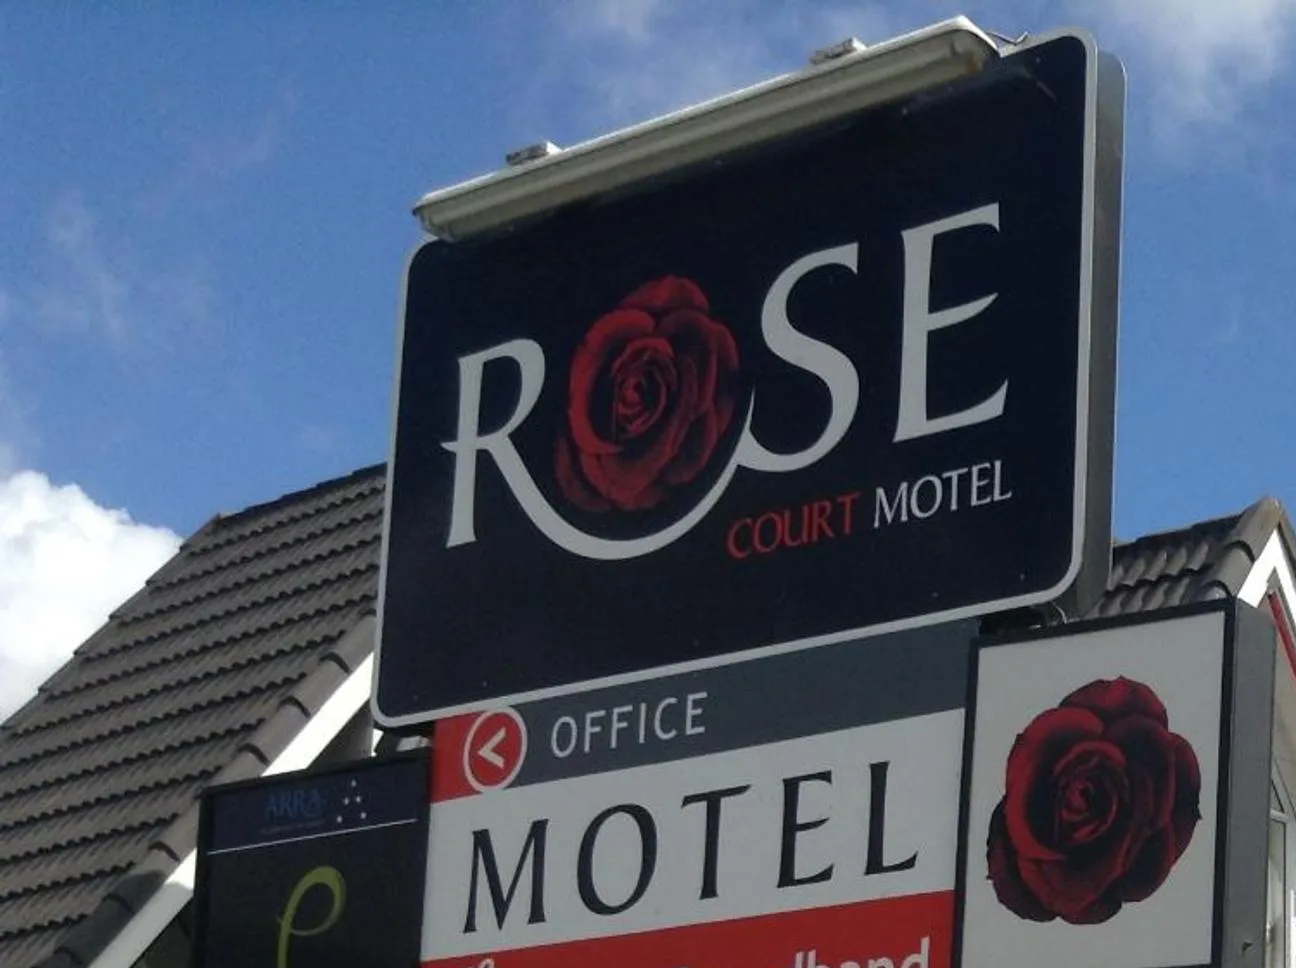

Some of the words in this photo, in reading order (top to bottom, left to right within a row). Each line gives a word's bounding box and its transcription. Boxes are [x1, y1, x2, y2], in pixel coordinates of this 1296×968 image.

[441, 203, 1008, 560] ROSE
[726, 491, 861, 559] COURT
[873, 460, 1012, 529] MOTEL
[551, 692, 707, 758] OFFICE
[463, 760, 918, 933] MOTEL
